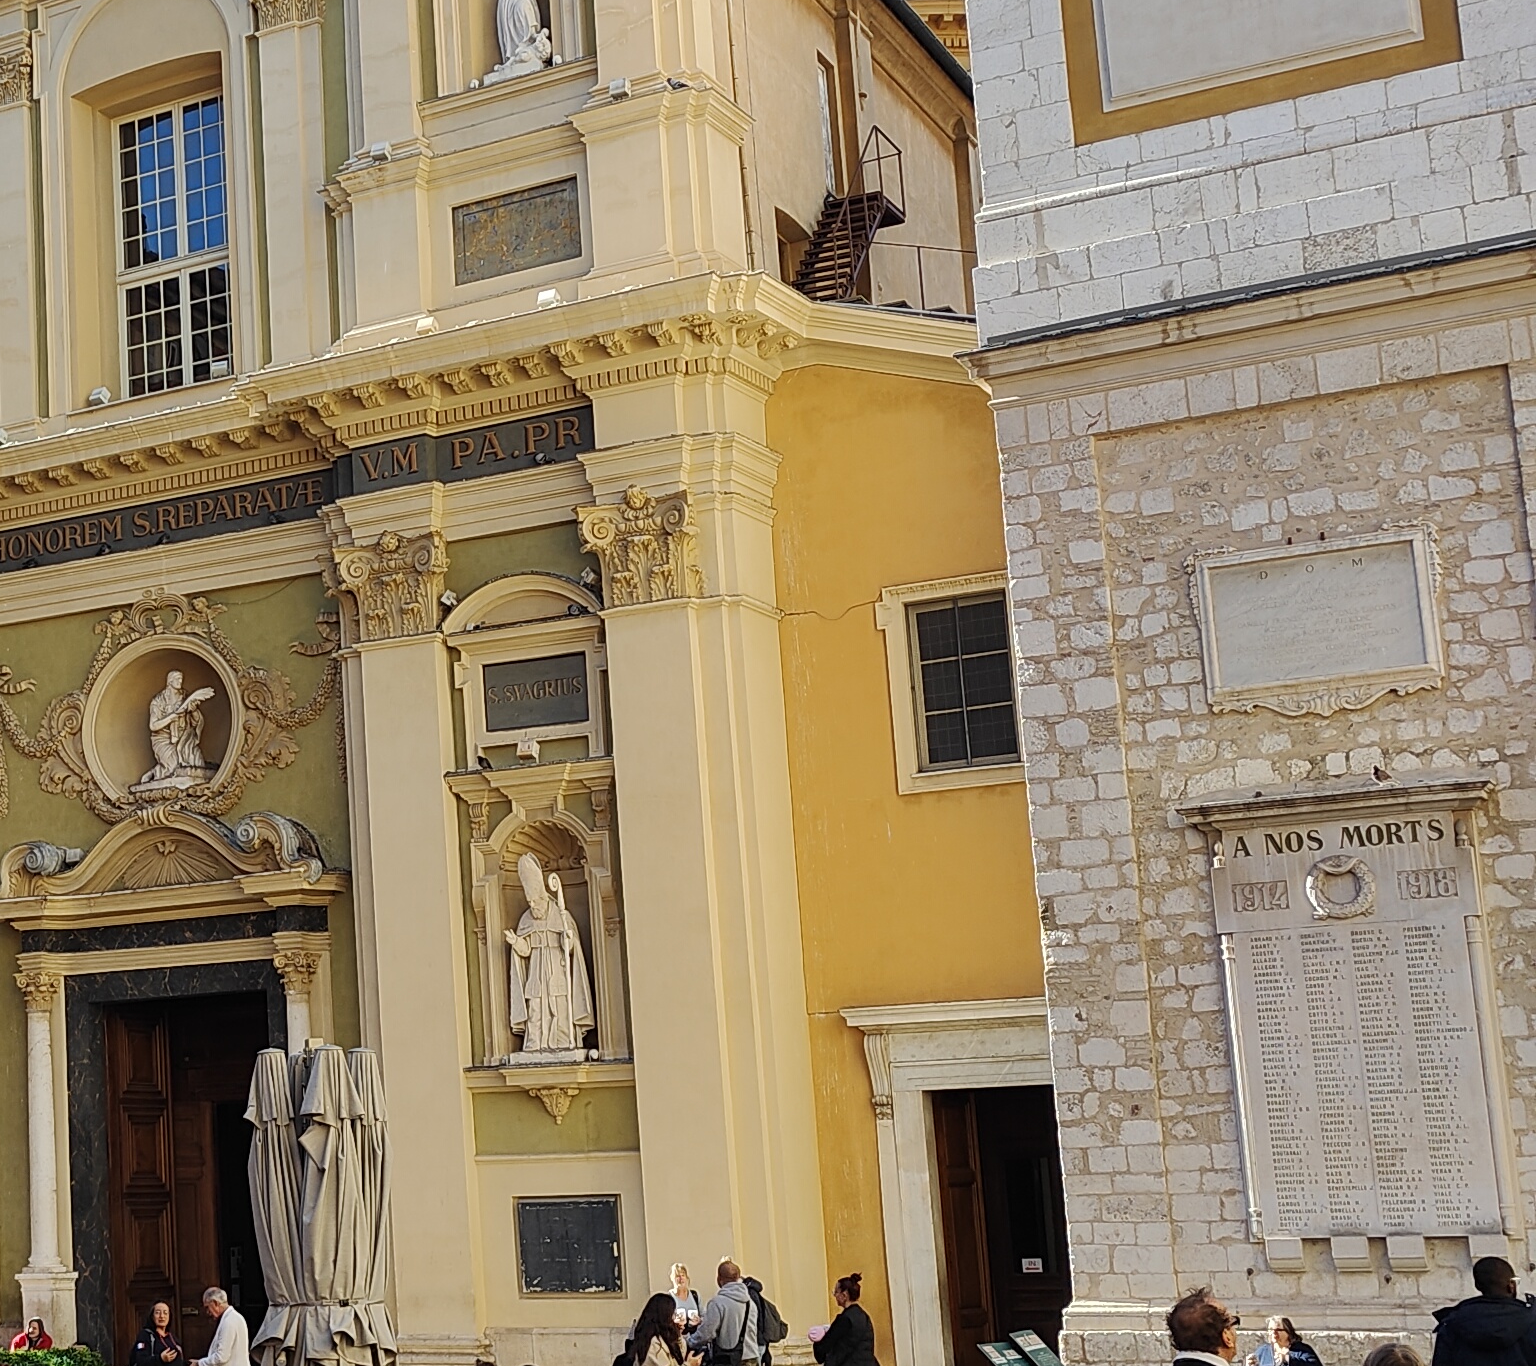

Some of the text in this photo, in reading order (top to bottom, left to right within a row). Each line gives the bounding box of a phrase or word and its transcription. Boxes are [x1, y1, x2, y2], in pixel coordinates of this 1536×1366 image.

[1232, 818, 1446, 859] A NOS MORTS
[1232, 867, 1459, 913] 1914 1918
